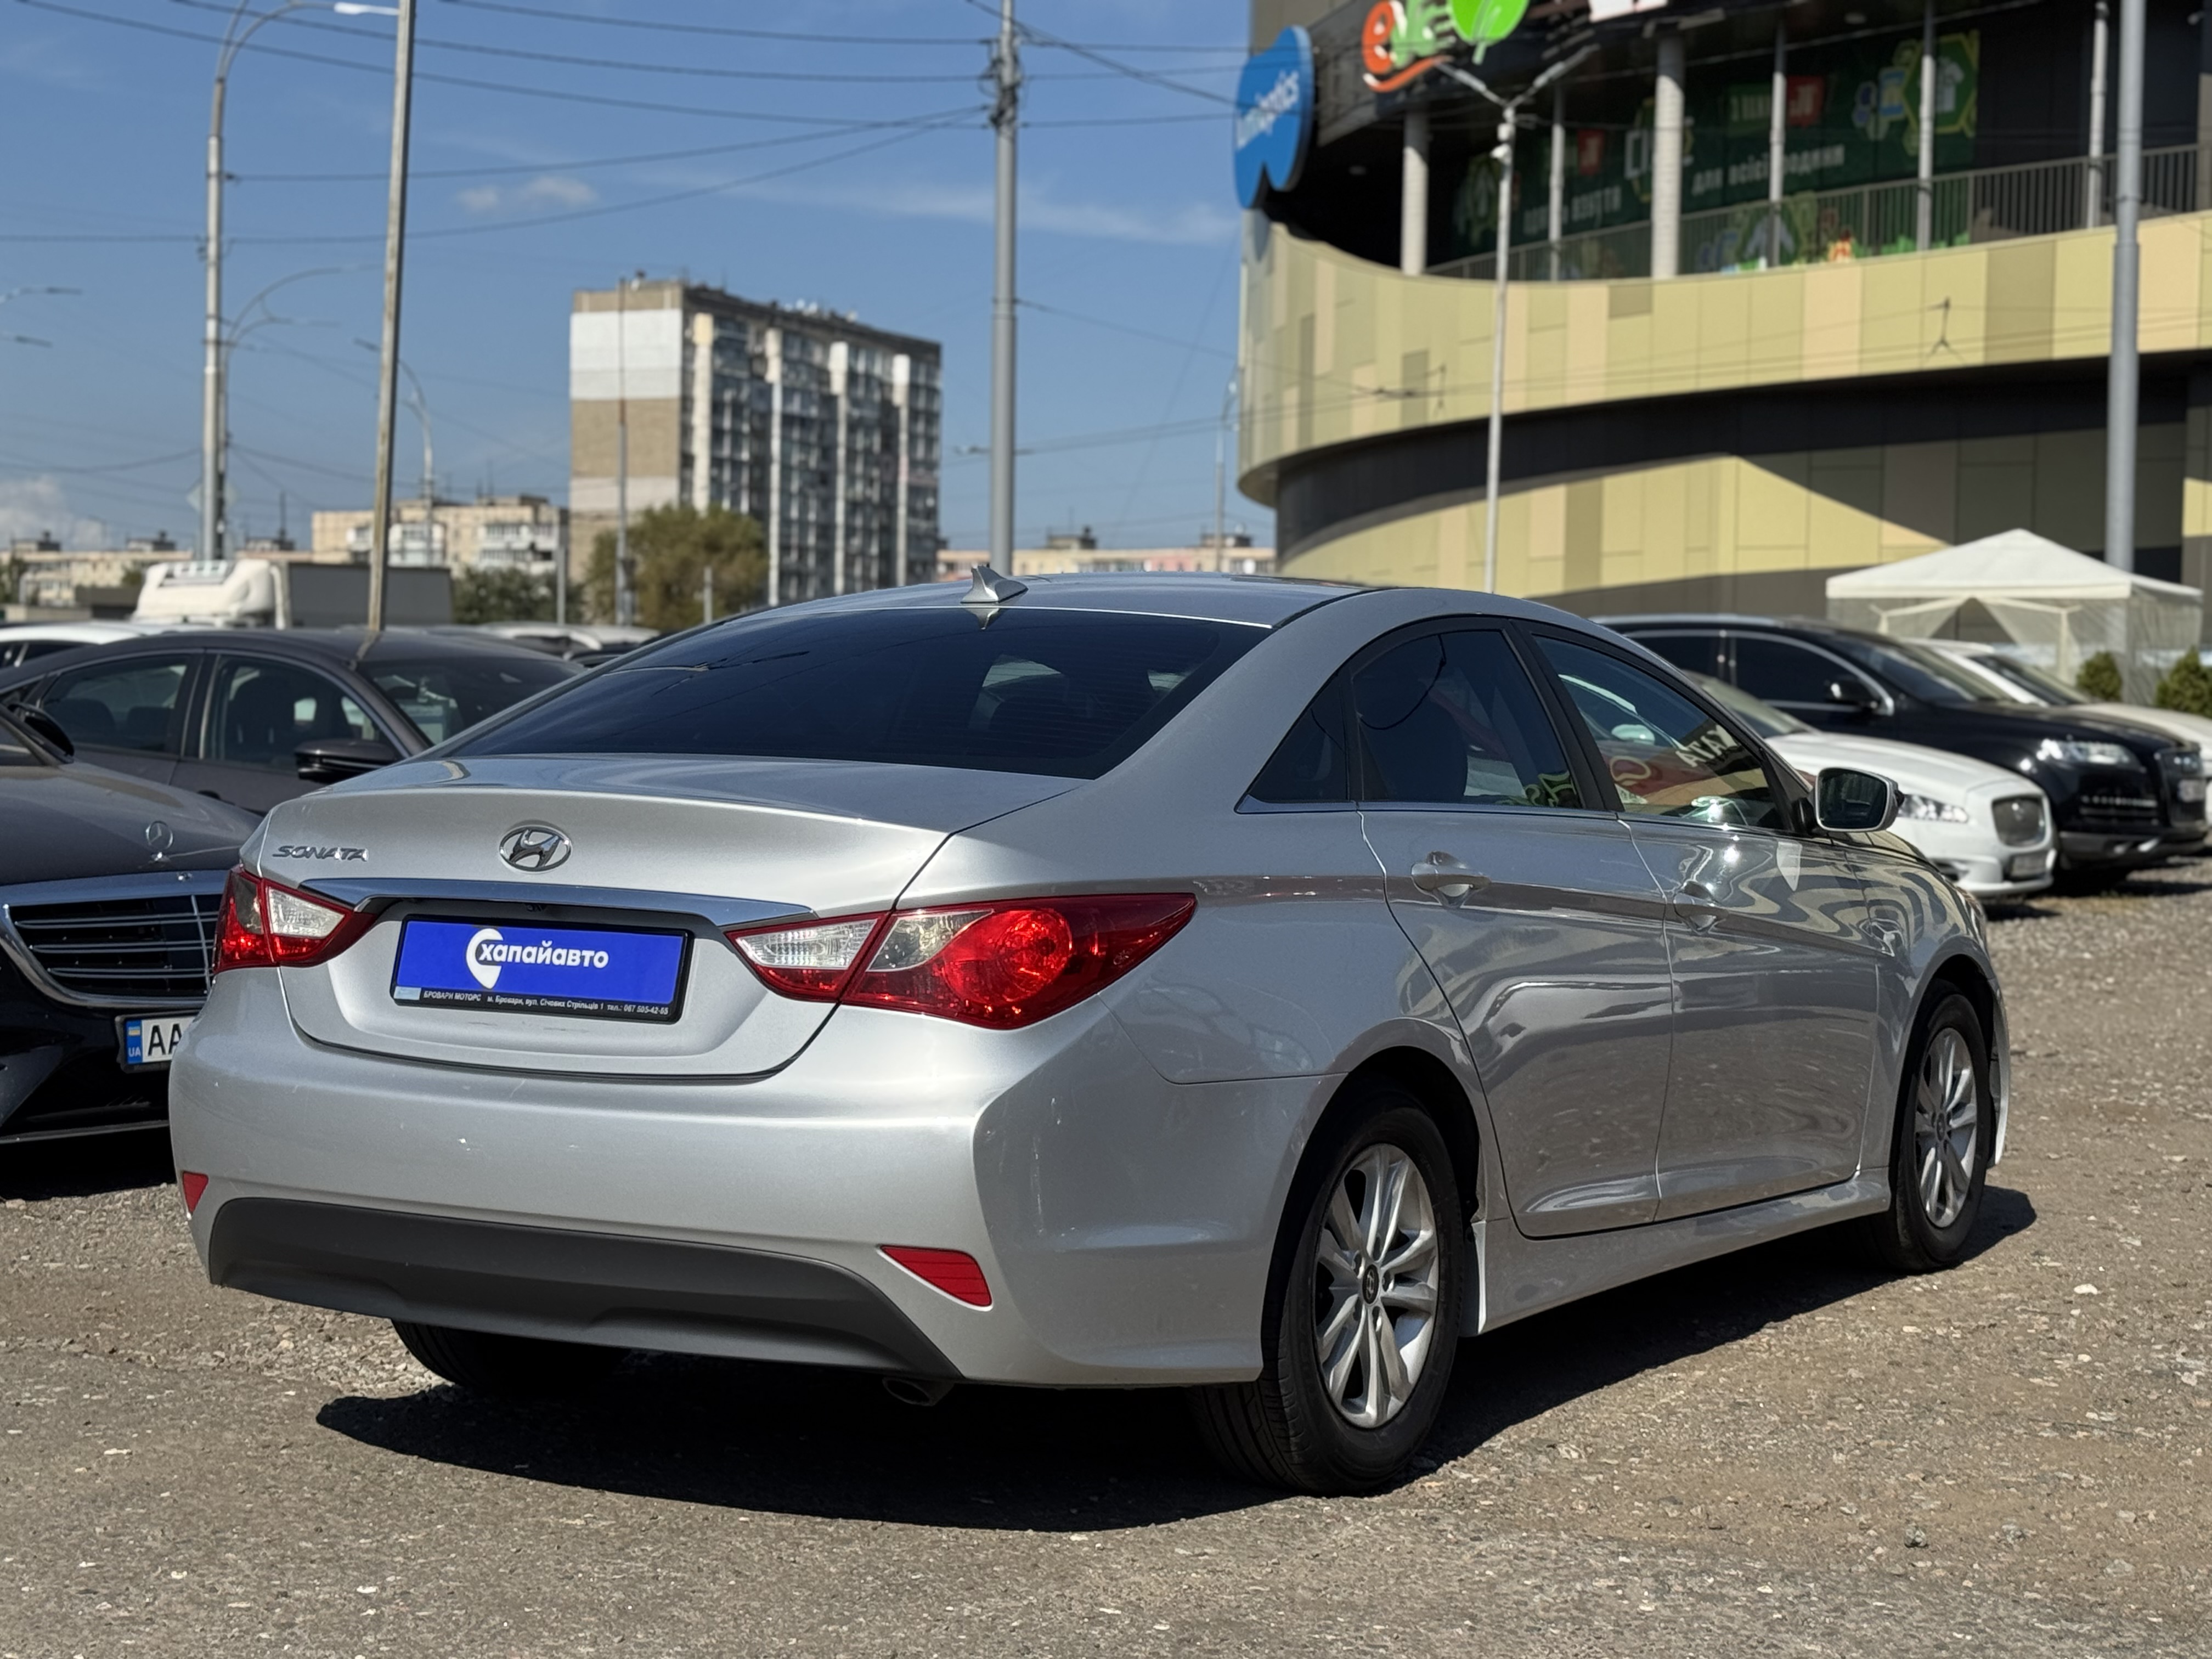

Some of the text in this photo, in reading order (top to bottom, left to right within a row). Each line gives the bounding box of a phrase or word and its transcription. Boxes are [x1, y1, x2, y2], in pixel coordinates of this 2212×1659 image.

[273, 845, 369, 863] SONATA
[423, 990, 454, 1000] БРОВАРИ
[454, 992, 482, 1002] МОТОРС
[128, 1047, 141, 1057] UA
